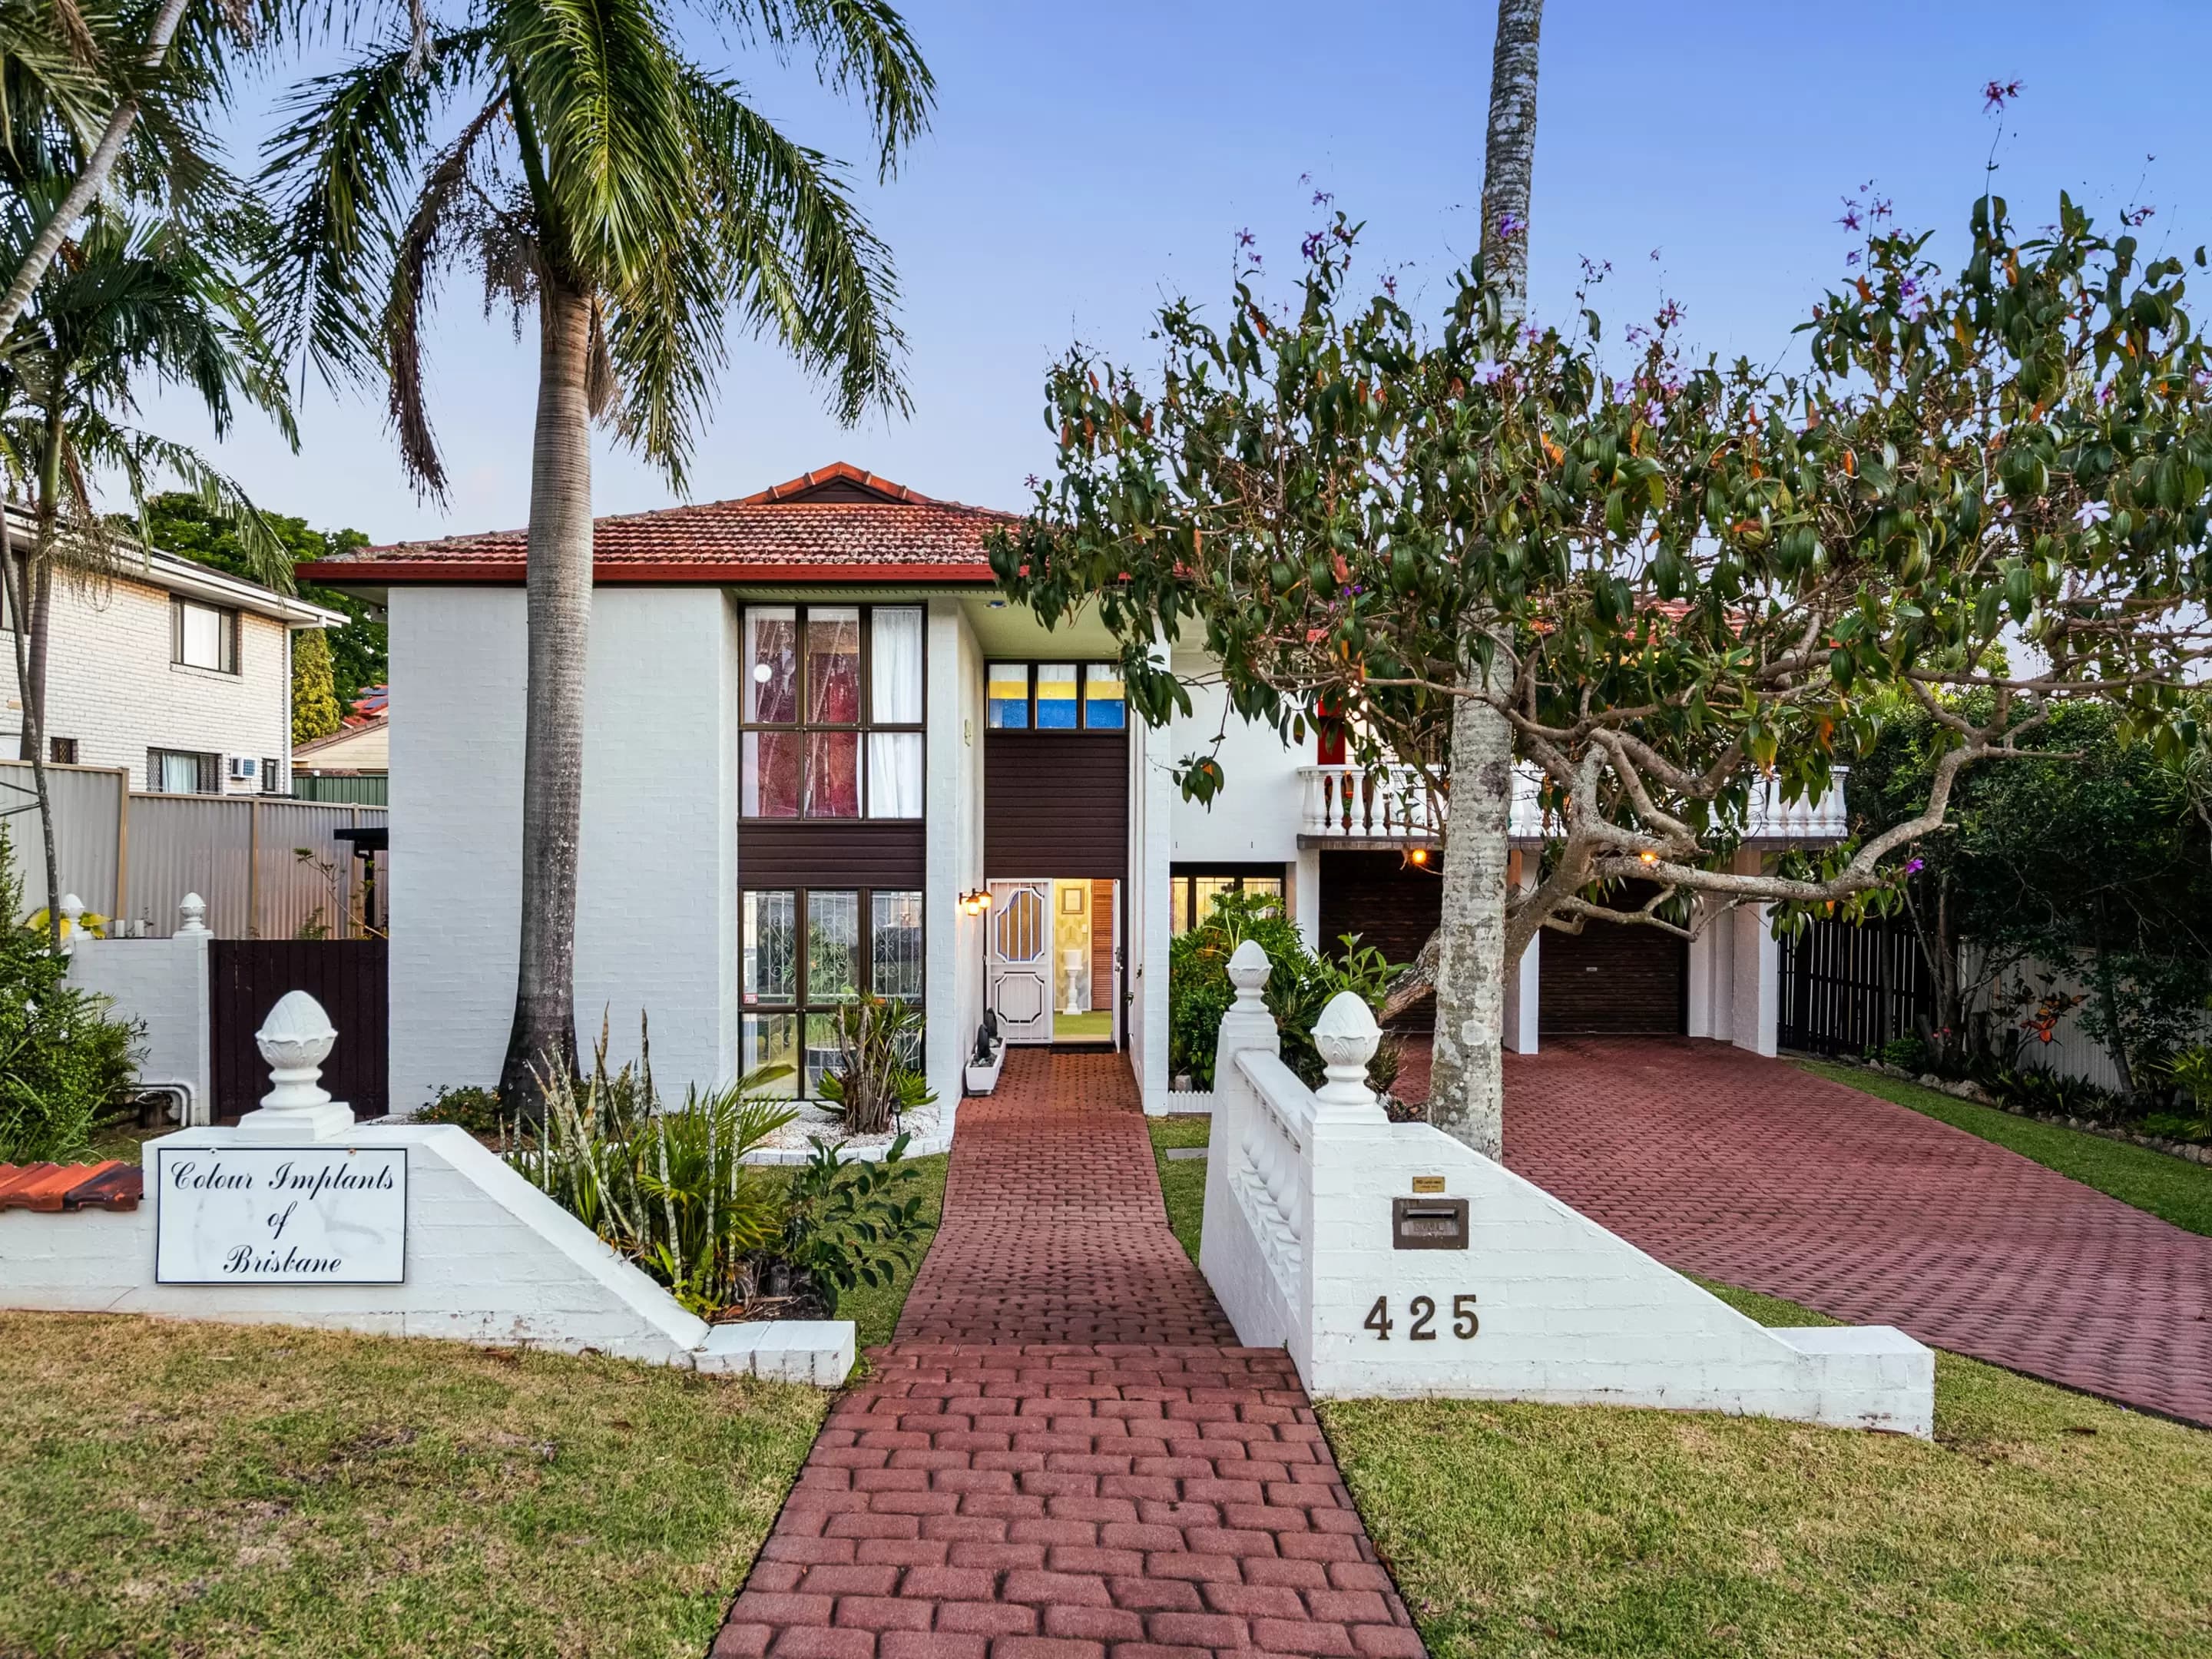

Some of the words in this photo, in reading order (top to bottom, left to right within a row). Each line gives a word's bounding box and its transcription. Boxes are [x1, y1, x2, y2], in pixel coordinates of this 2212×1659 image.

[171, 1161, 253, 1190] Colour
[268, 1161, 393, 1200] Implants
[267, 1200, 297, 1240] of
[223, 1245, 342, 1273] Brisbane
[1364, 1294, 1479, 1340] 425
